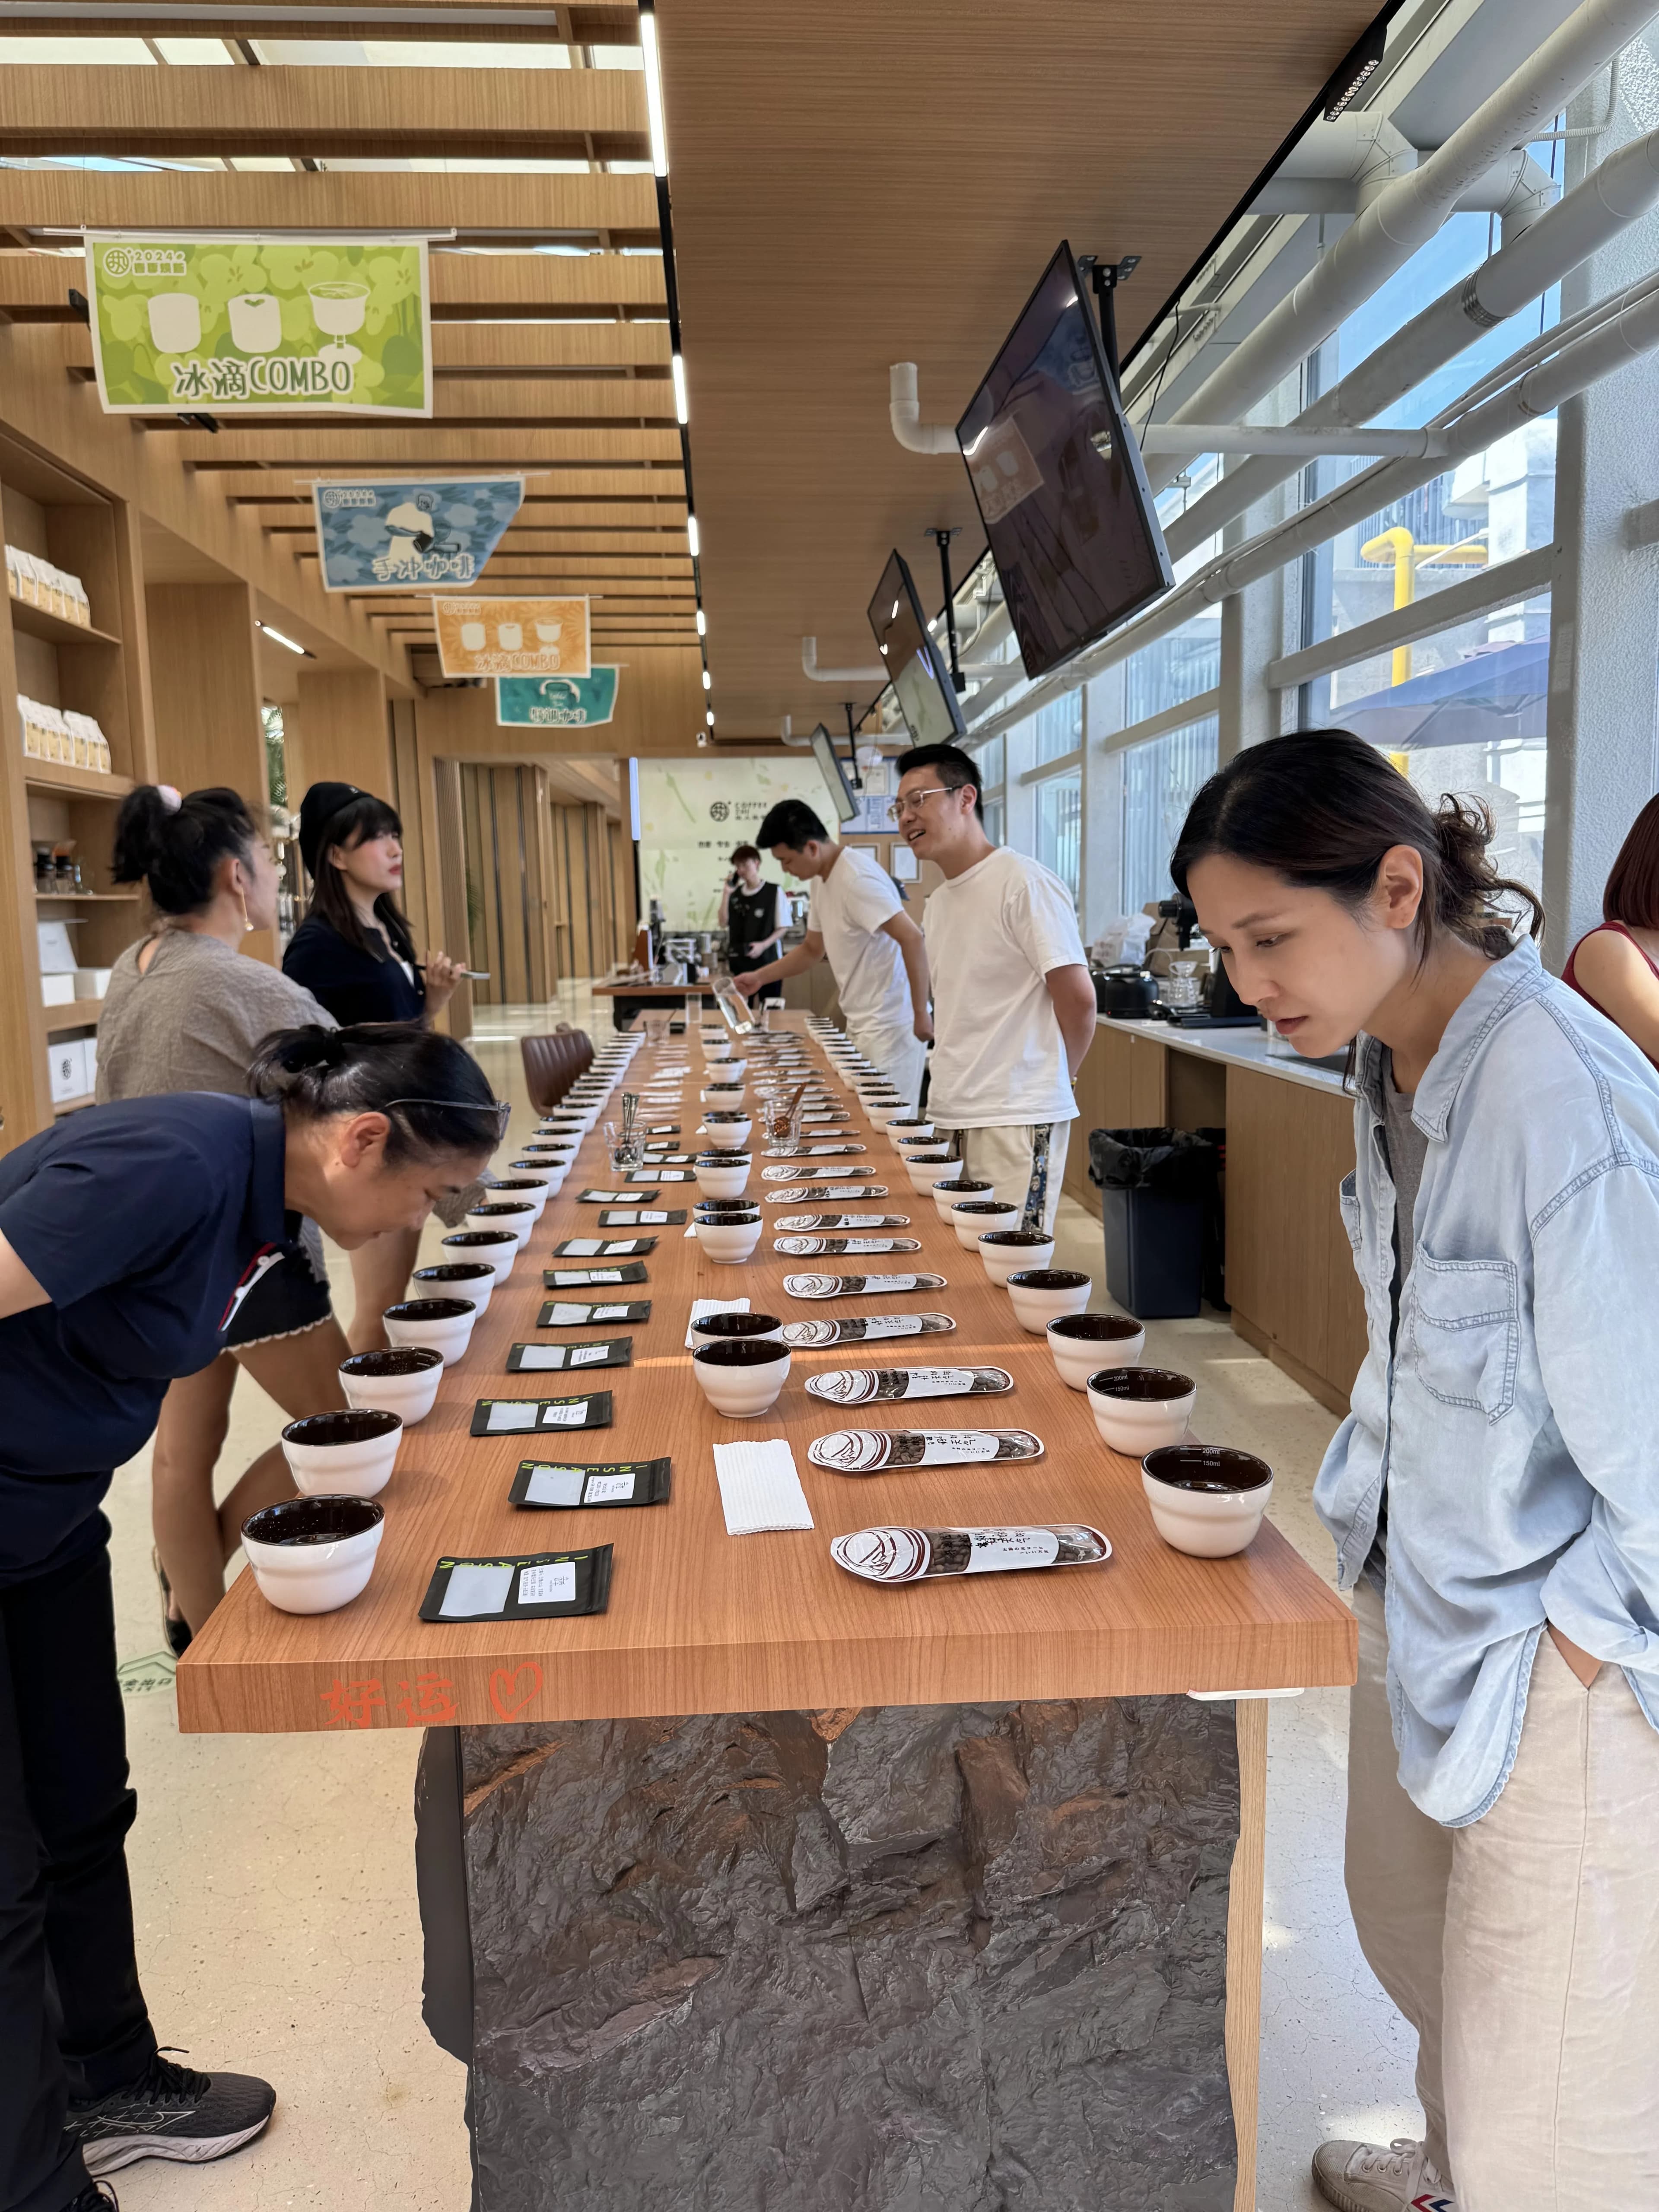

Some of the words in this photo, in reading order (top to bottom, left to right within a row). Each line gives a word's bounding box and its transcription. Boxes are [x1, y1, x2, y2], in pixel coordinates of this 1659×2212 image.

[134, 252, 172, 261] 2024
[175, 361, 350, 395] 冰滴COMBO
[374, 555, 474, 579] 手冲咖啡
[321, 1671, 460, 1728] 好运
